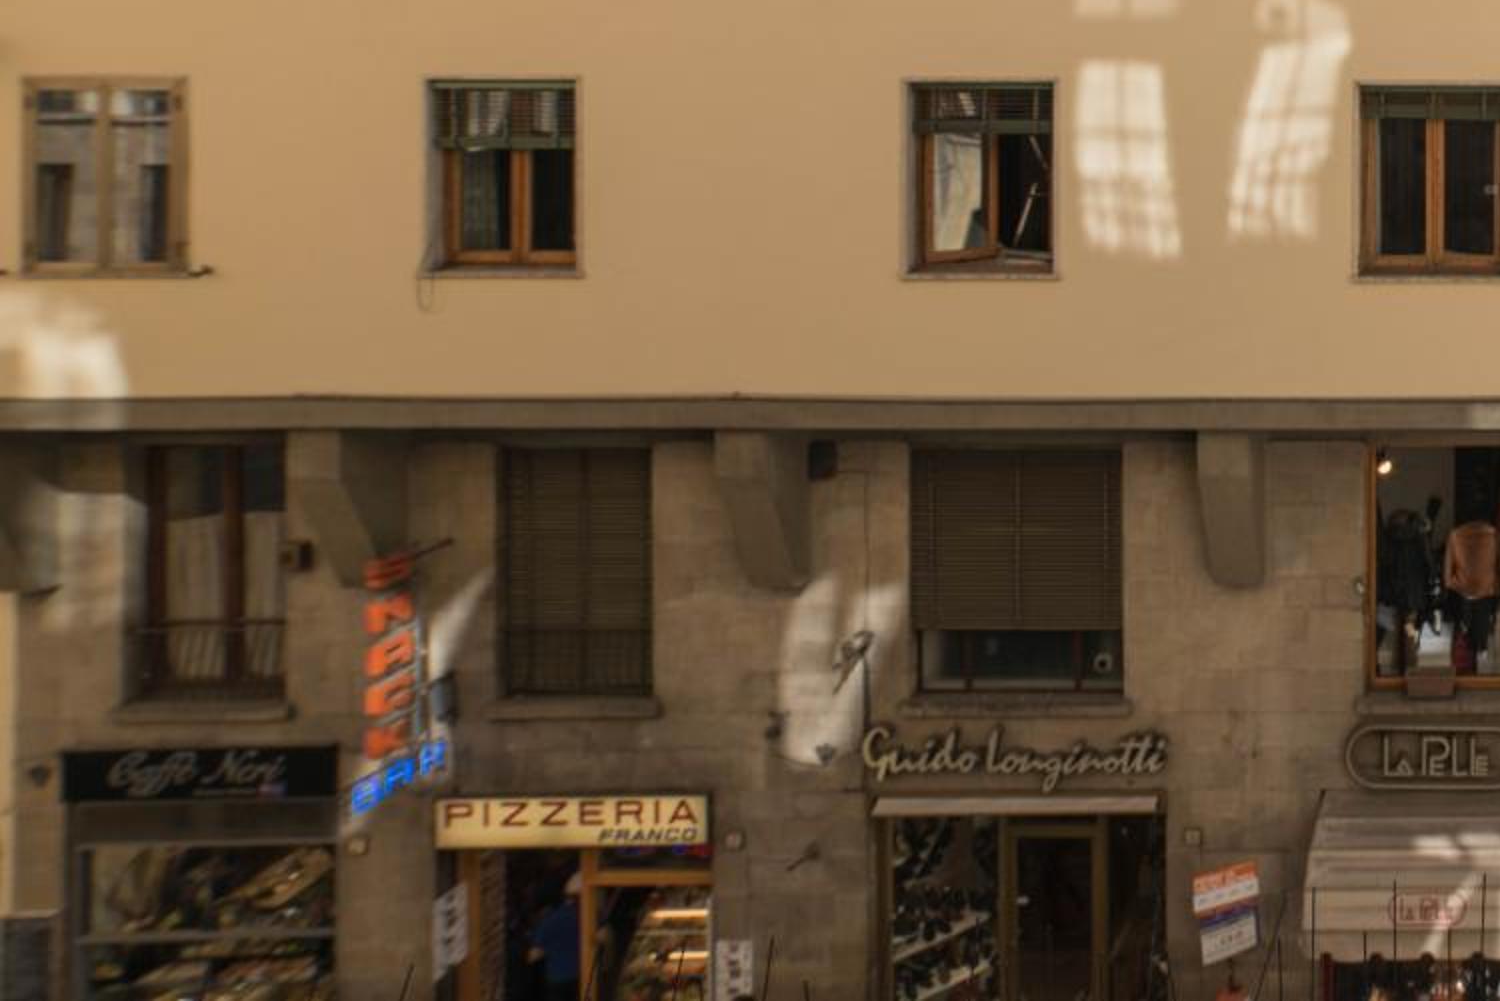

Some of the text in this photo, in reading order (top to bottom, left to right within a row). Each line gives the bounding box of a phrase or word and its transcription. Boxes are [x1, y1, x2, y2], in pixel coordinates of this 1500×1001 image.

[862, 727, 1167, 793] Guido Longinotti
[1384, 735, 1414, 776] LA
[351, 738, 447, 815] BAR
[444, 800, 699, 828] PIZZERIA
[597, 827, 698, 842] FRANCO
